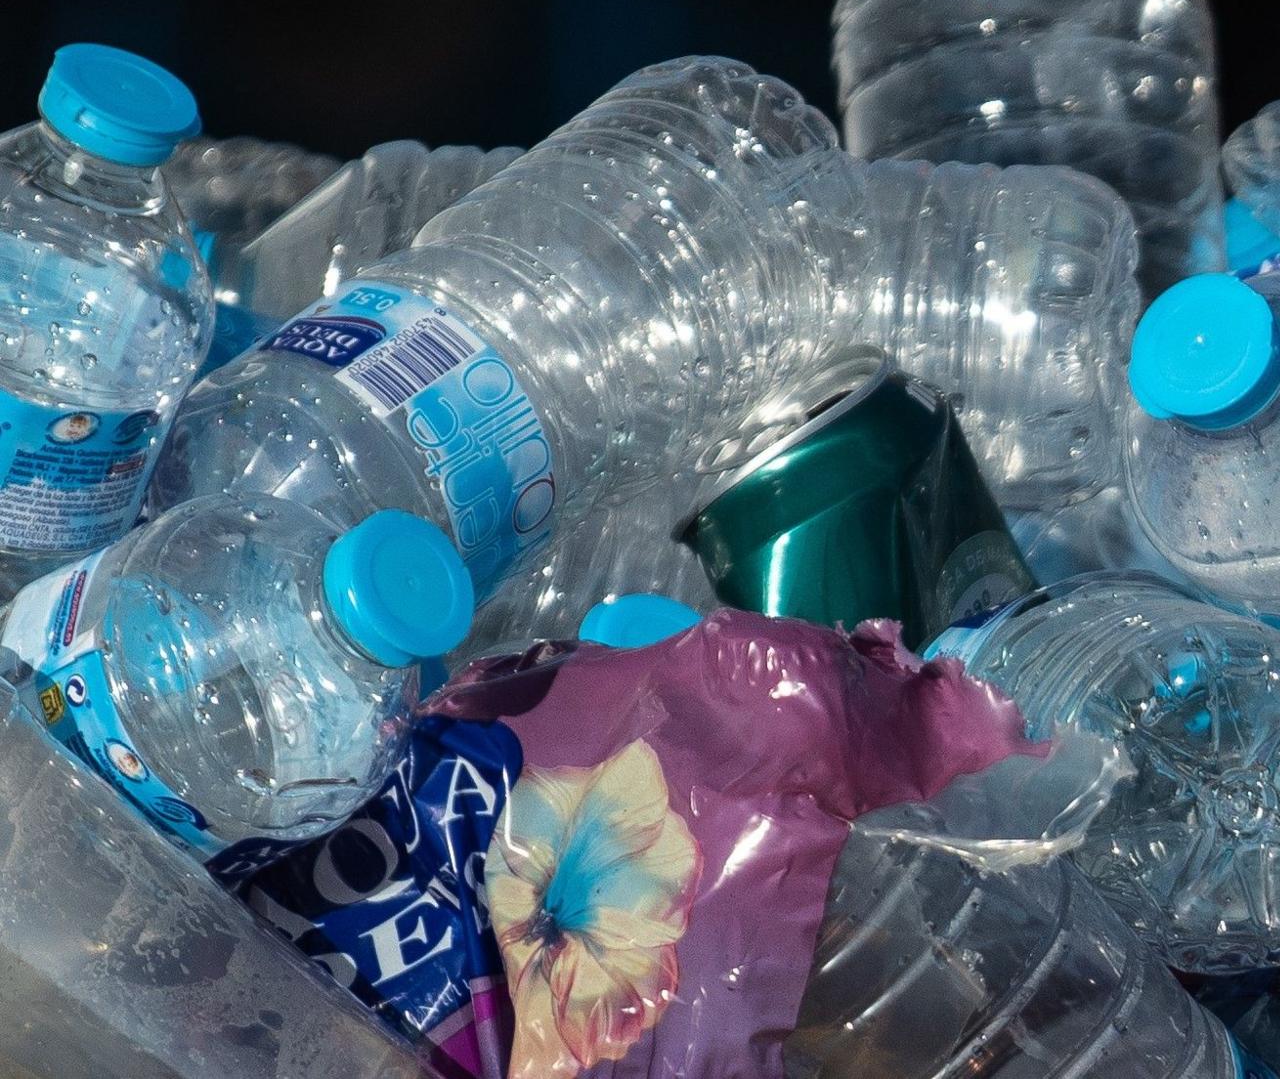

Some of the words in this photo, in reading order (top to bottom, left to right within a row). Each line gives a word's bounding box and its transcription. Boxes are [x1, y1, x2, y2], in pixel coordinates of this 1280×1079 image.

[350, 289, 394, 311] 0,5L
[272, 336, 347, 360] AQUA
[286, 324, 361, 349] DEUS
